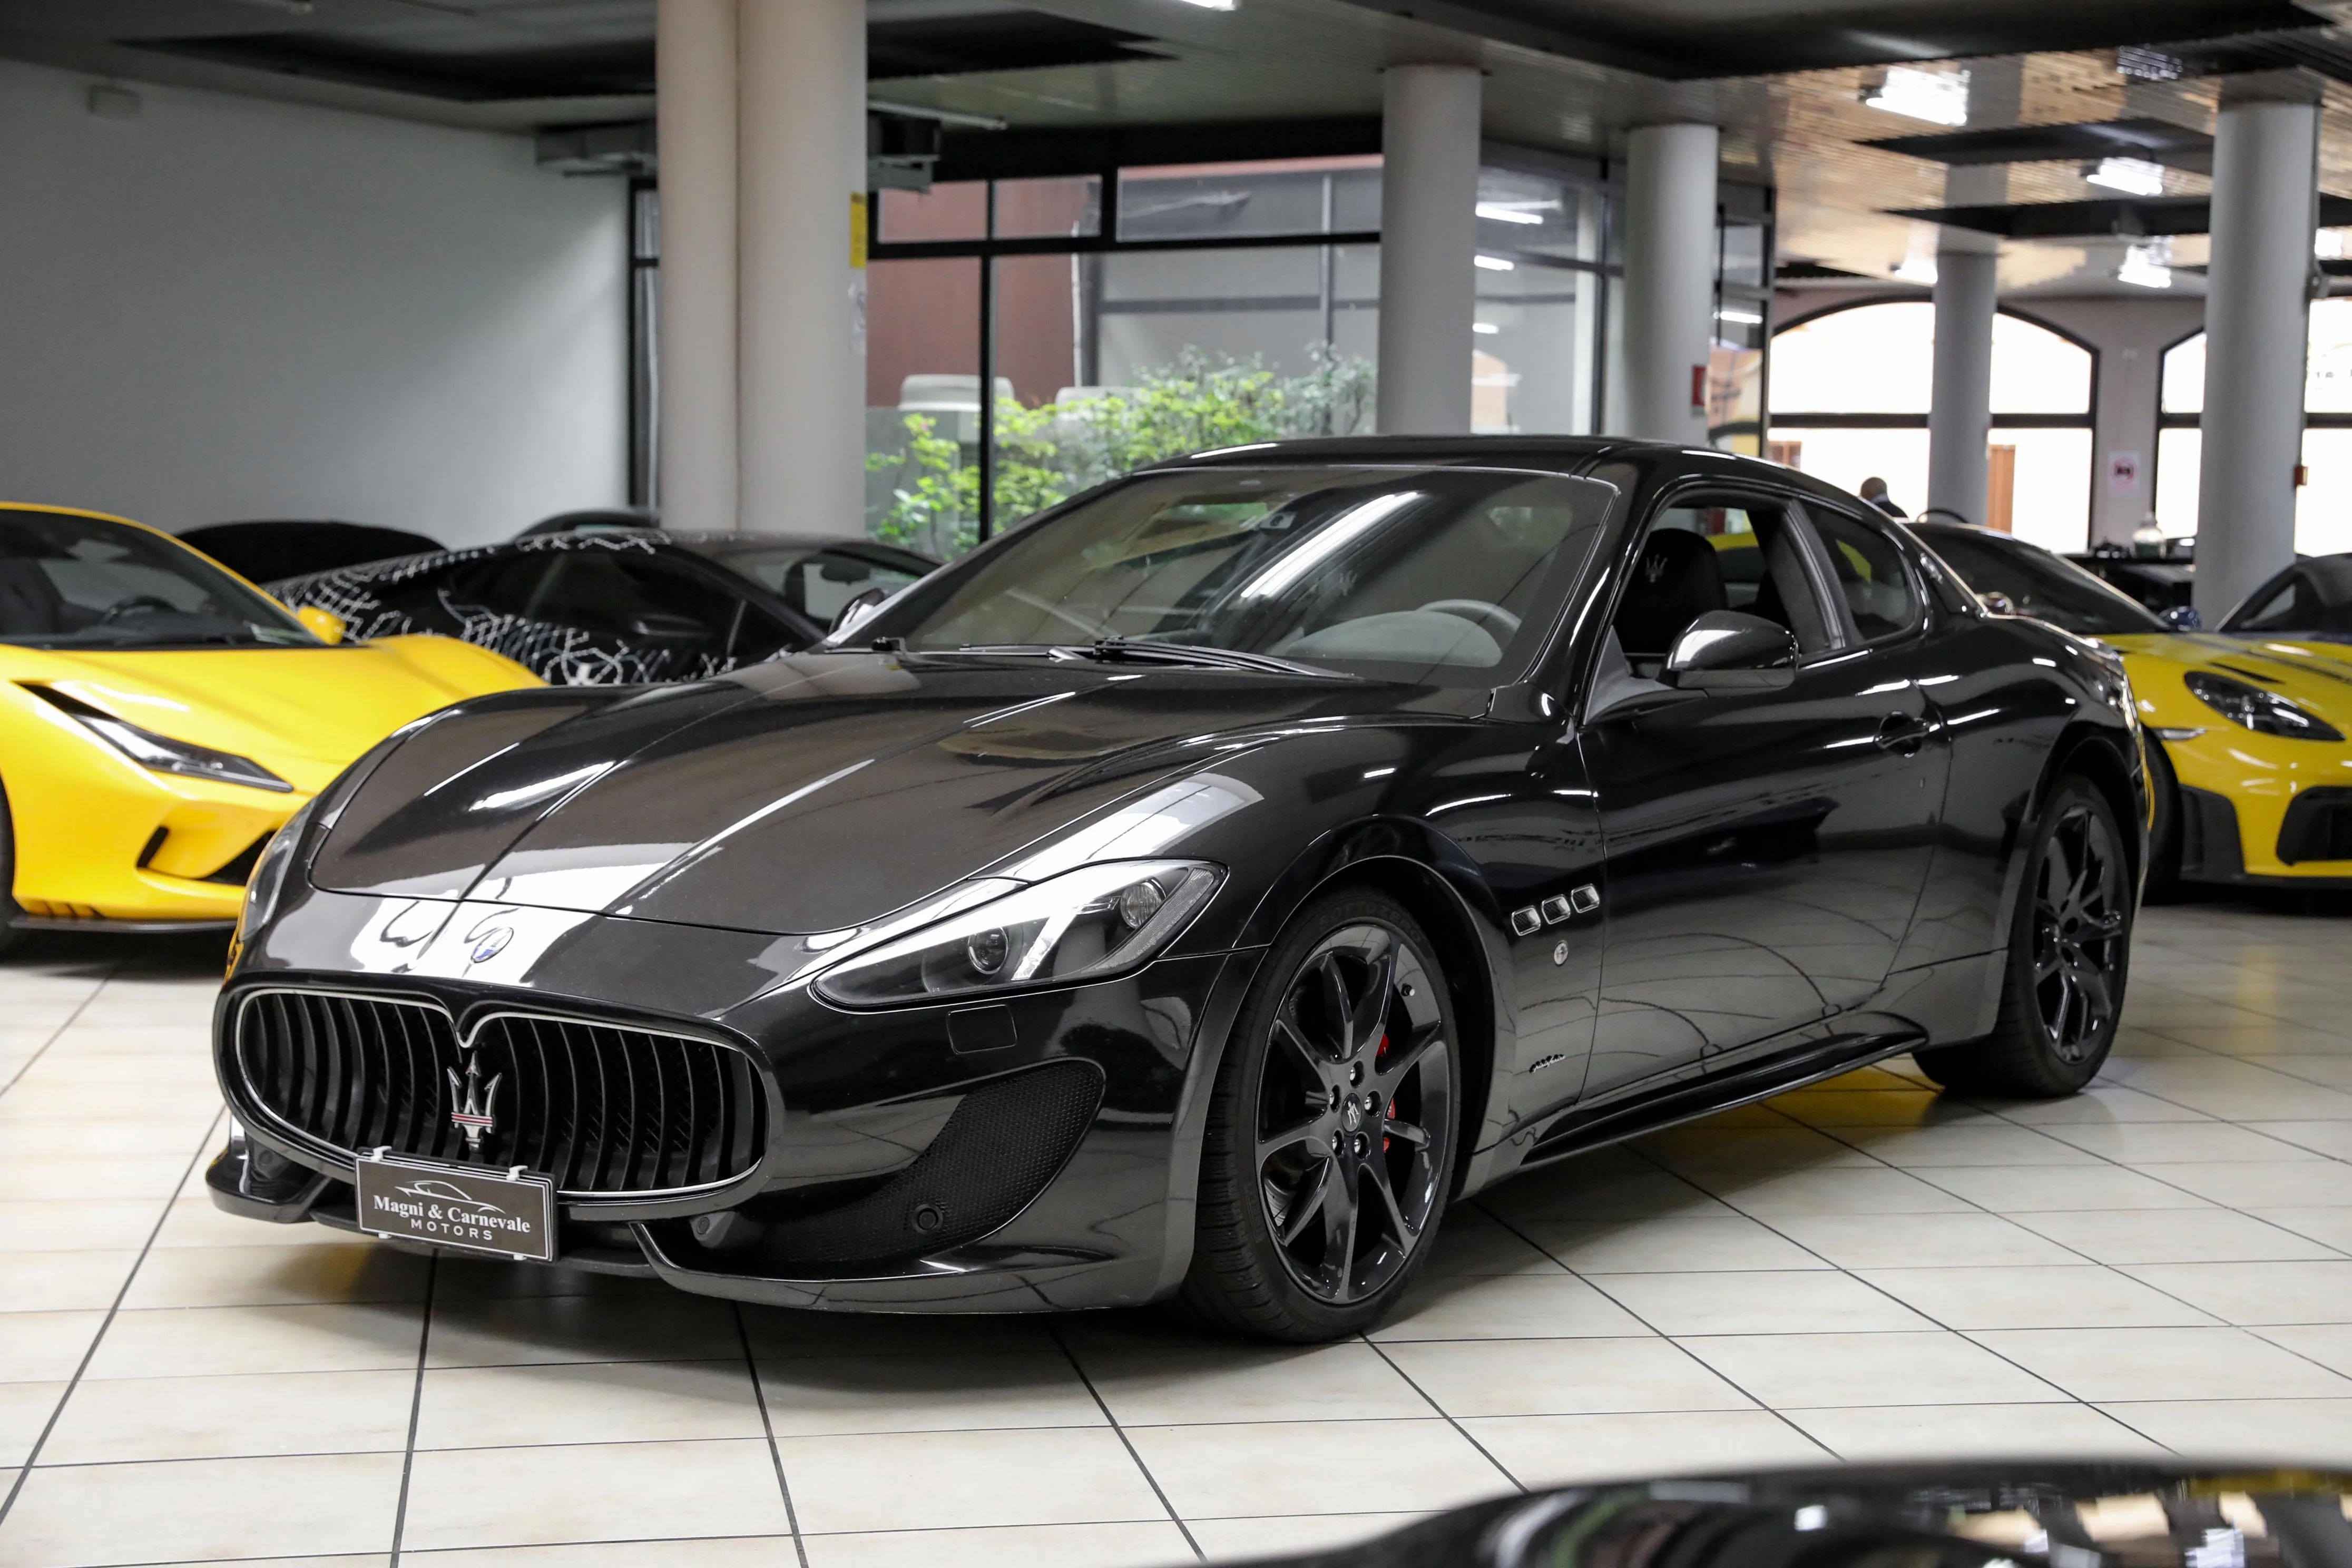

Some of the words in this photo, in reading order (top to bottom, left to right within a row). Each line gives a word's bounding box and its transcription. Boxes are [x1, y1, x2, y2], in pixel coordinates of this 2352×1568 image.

[373, 1195, 424, 1218] Magni
[428, 1204, 443, 1220] &
[447, 1207, 531, 1233] Carnevale
[410, 1218, 493, 1240] MOTORS
